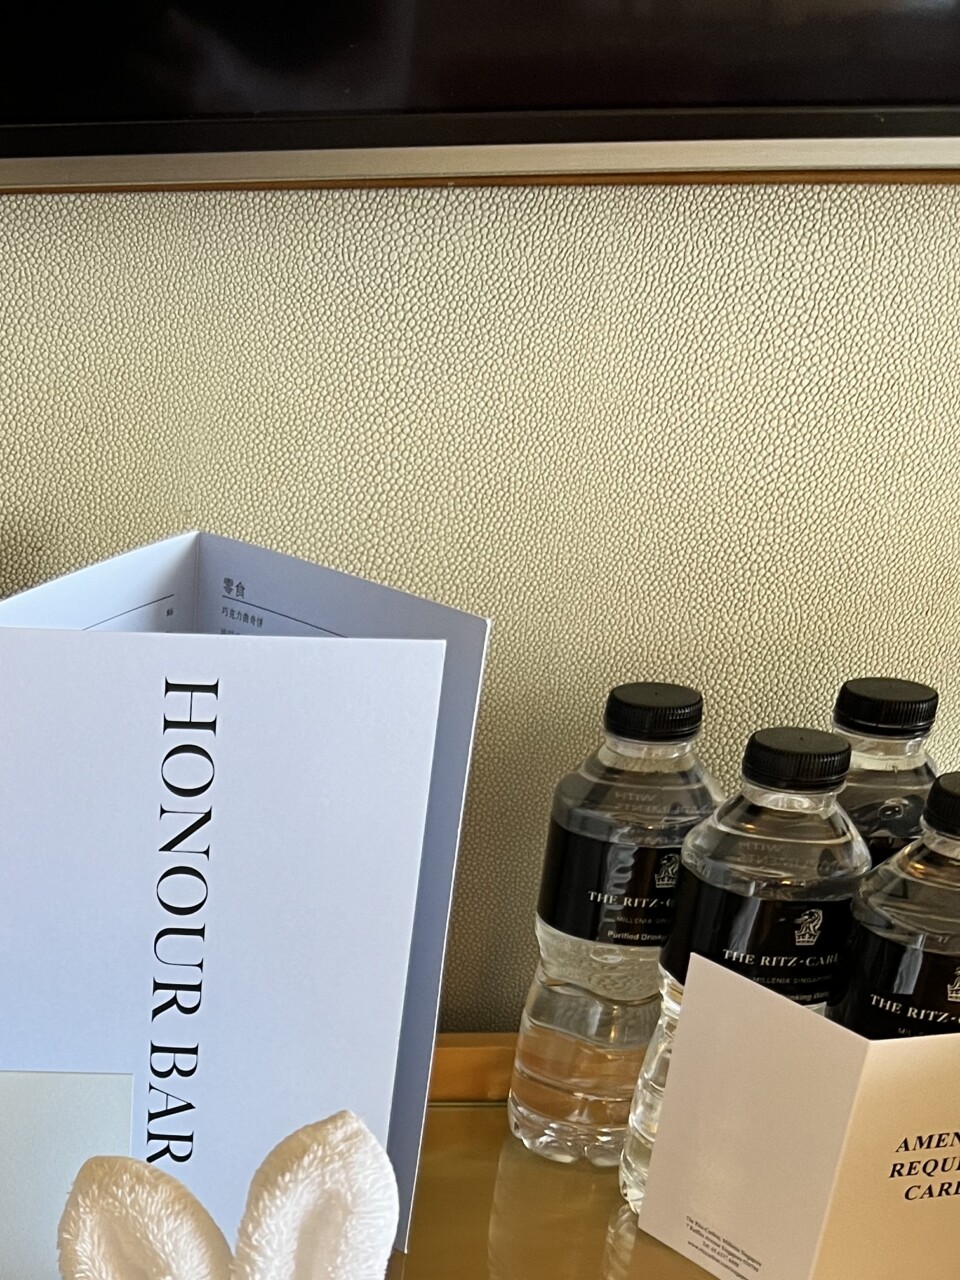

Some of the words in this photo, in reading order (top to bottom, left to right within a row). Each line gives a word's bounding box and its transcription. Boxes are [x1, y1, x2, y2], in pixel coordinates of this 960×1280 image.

[151, 676, 219, 1022] HONOUR
[588, 891, 618, 905] THE
[723, 949, 755, 965] THE
[870, 994, 902, 1014] THE
[145, 1040, 199, 1164] BAR
[888, 1156, 960, 1178] REQU
